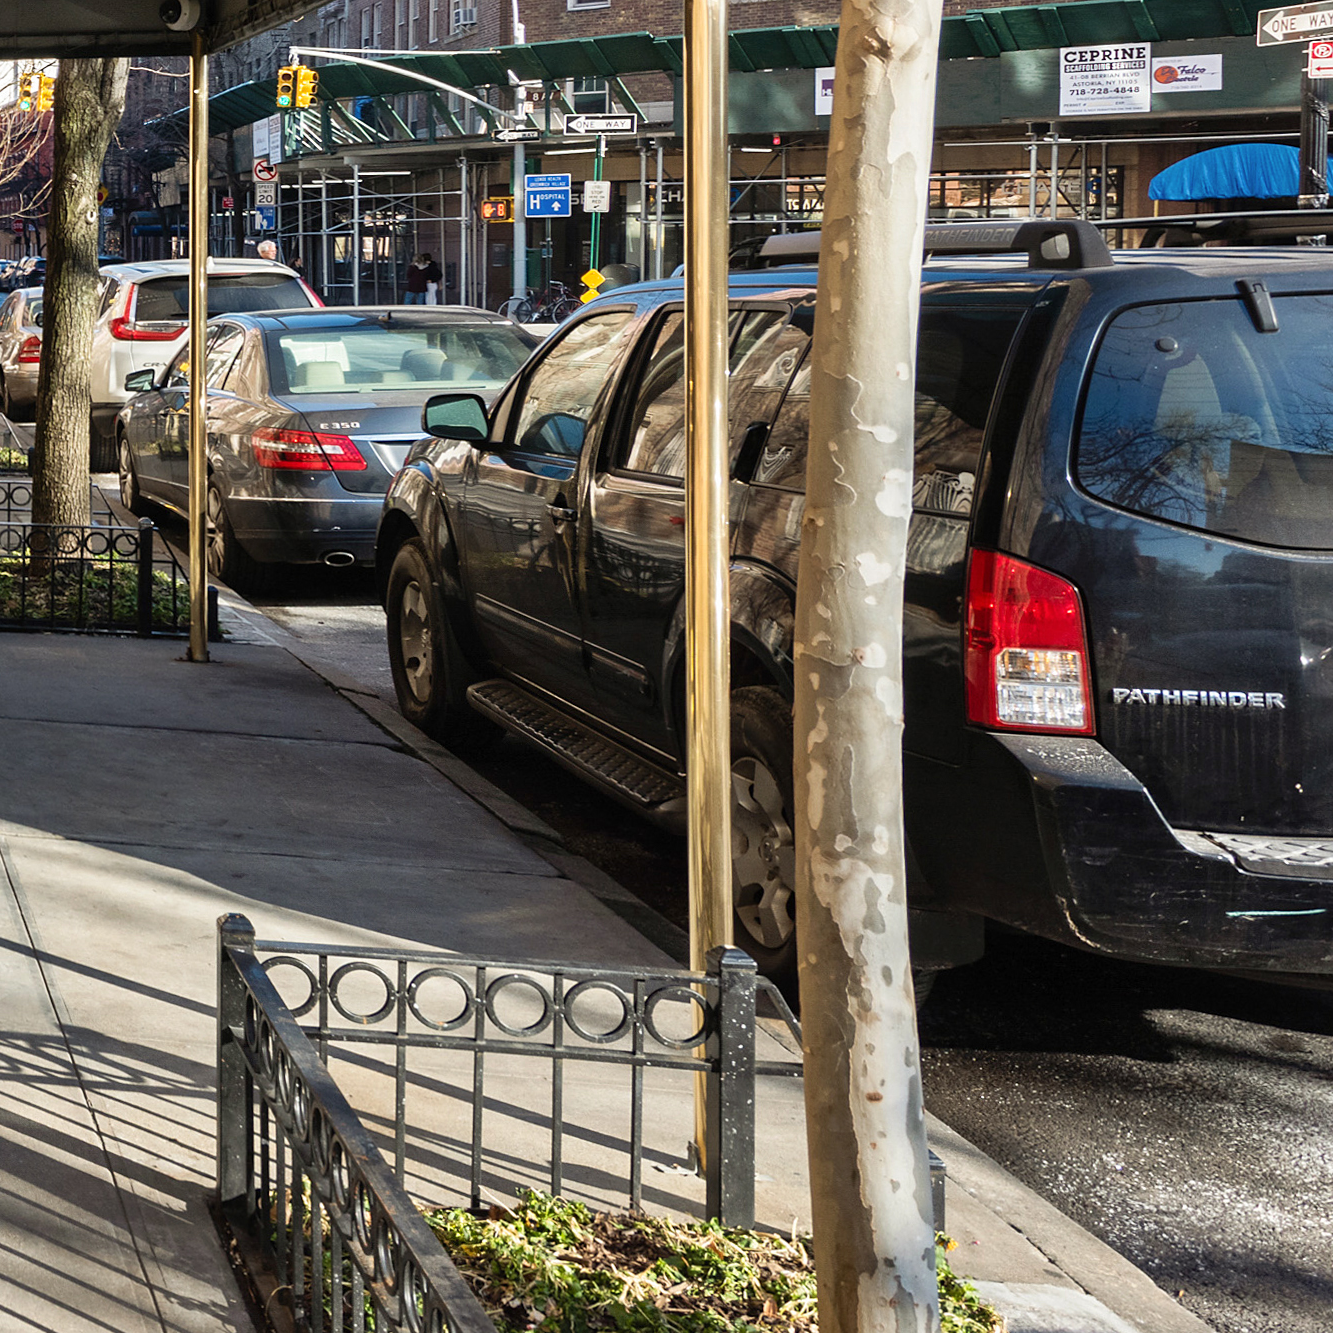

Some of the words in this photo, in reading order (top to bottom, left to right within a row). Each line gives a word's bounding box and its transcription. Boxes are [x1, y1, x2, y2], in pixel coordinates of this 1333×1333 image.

[1272, 18, 1297, 33] ONE
[1064, 47, 1146, 63] CEPRINE
[1065, 62, 1111, 73] SCAFFOLDING
[1111, 60, 1145, 69] SERVICES
[1177, 64, 1207, 75] Falco
[533, 92, 539, 101] 8
[1069, 86, 1140, 96] 718-728-4848
[258, 194, 273, 203] 20
[529, 194, 565, 210] HOSPITAL
[497, 203, 505, 216] 8
[925, 227, 1015, 243] PATHFINDER
[320, 422, 329, 430] E
[331, 421, 360, 429] 350
[1112, 687, 1286, 709] PATHFINDER
